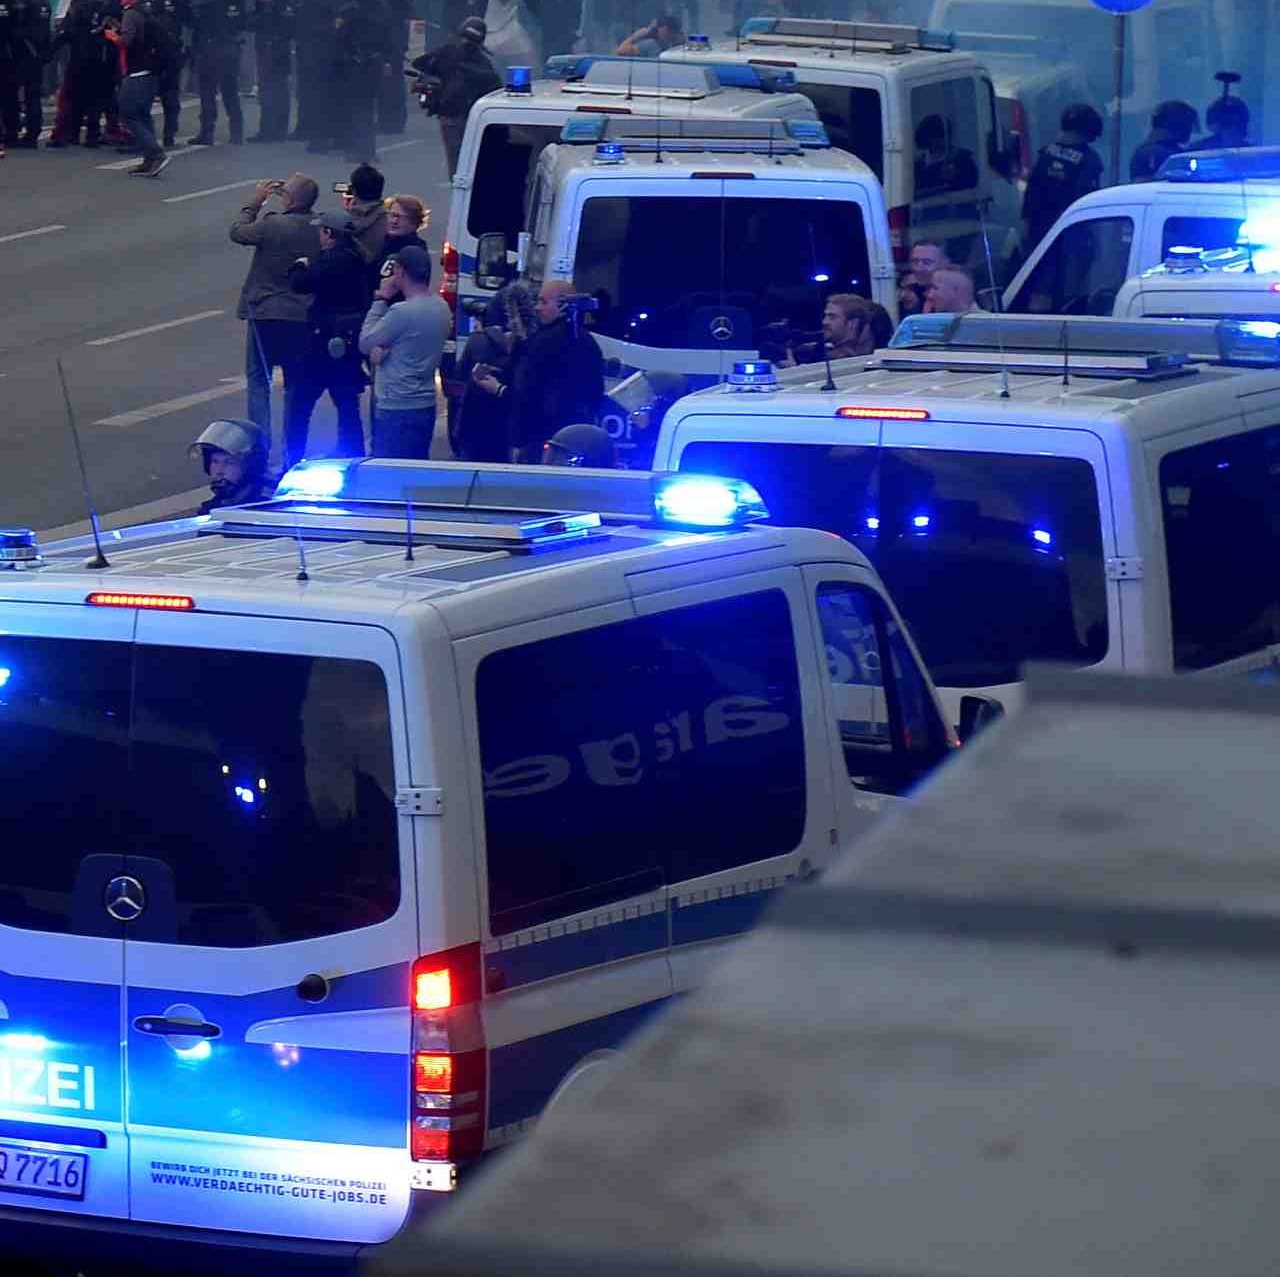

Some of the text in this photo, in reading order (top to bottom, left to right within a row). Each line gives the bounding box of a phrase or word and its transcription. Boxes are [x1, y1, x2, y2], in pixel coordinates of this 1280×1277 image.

[15, 1153, 80, 1189] 7716
[150, 1161, 187, 1173] BEWIRB
[189, 1165, 211, 1175] DICH
[213, 1167, 240, 1178] JETZT
[242, 1170, 258, 1180] BEI
[260, 1172, 278, 1181] DER
[349, 1180, 387, 1191] POLIZEI
[150, 1173, 388, 1205] WWW.VERDAECHTIG-GUTE-JOBS.DE
